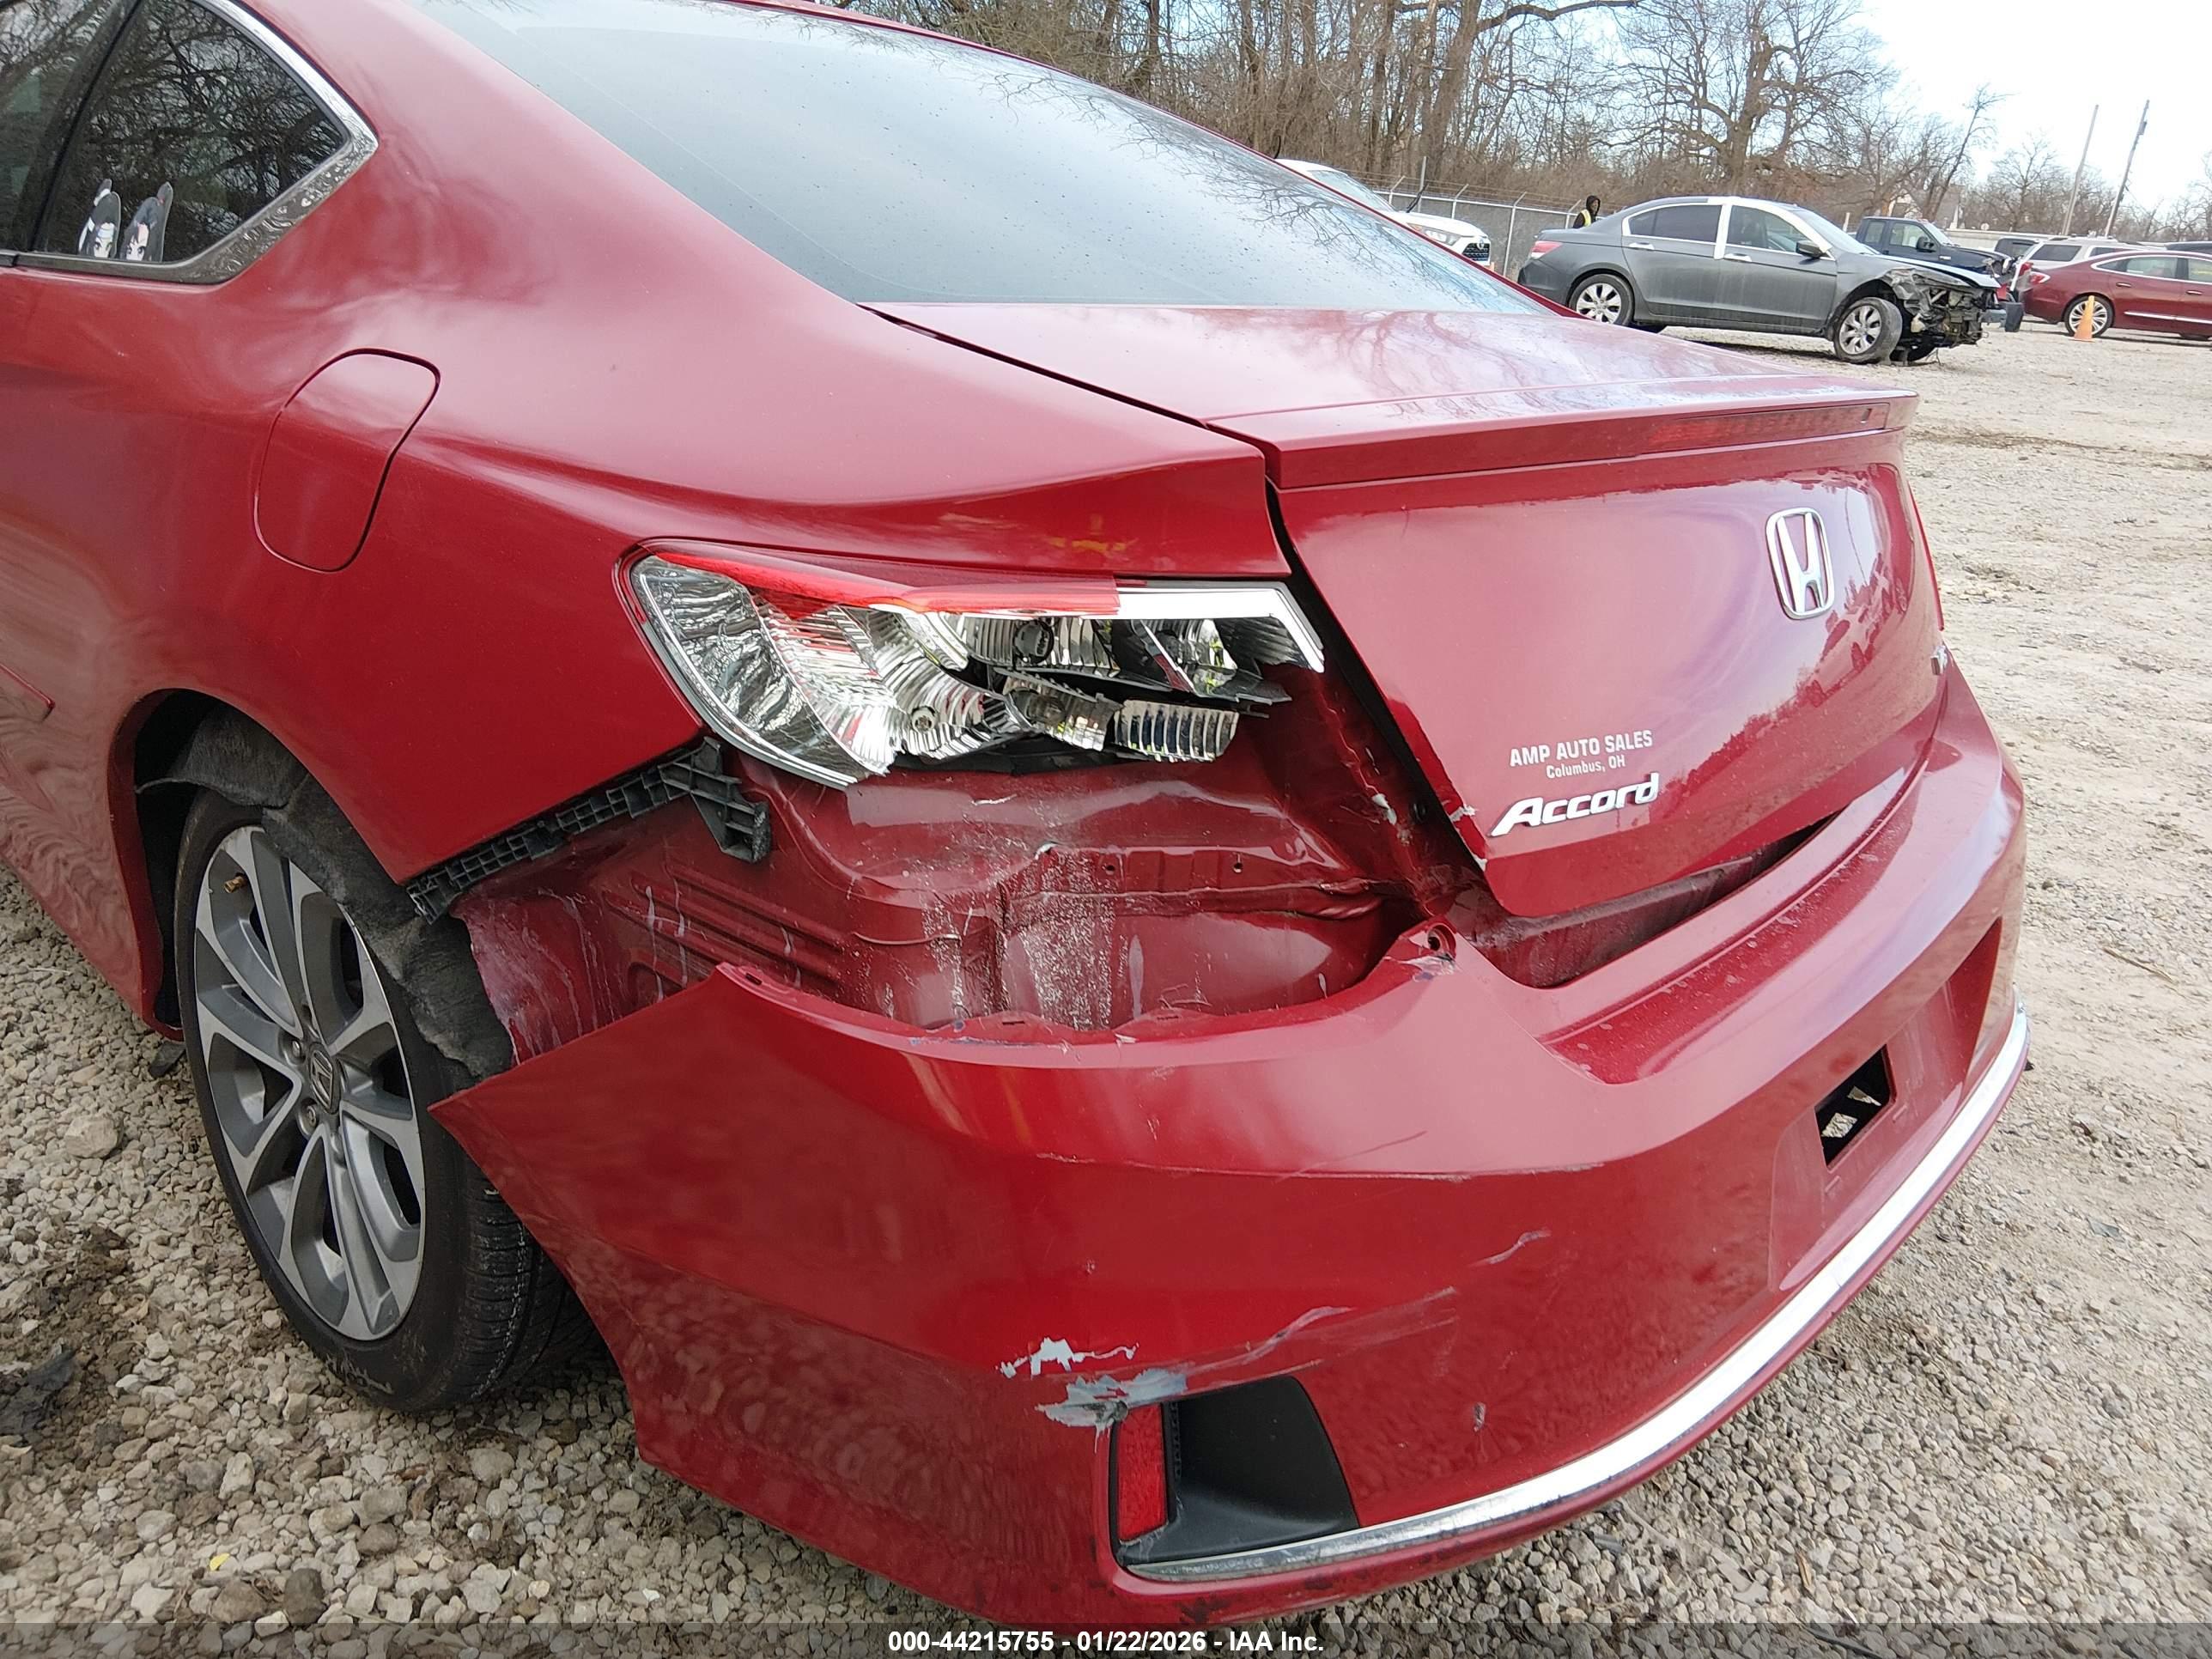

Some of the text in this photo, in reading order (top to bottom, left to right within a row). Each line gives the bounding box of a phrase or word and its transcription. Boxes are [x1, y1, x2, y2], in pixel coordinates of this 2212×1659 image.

[1510, 730, 1653, 767] AMP AUTO SALES
[1547, 755, 1626, 779] Columbus, OH
[1489, 772, 1660, 837] Accord
